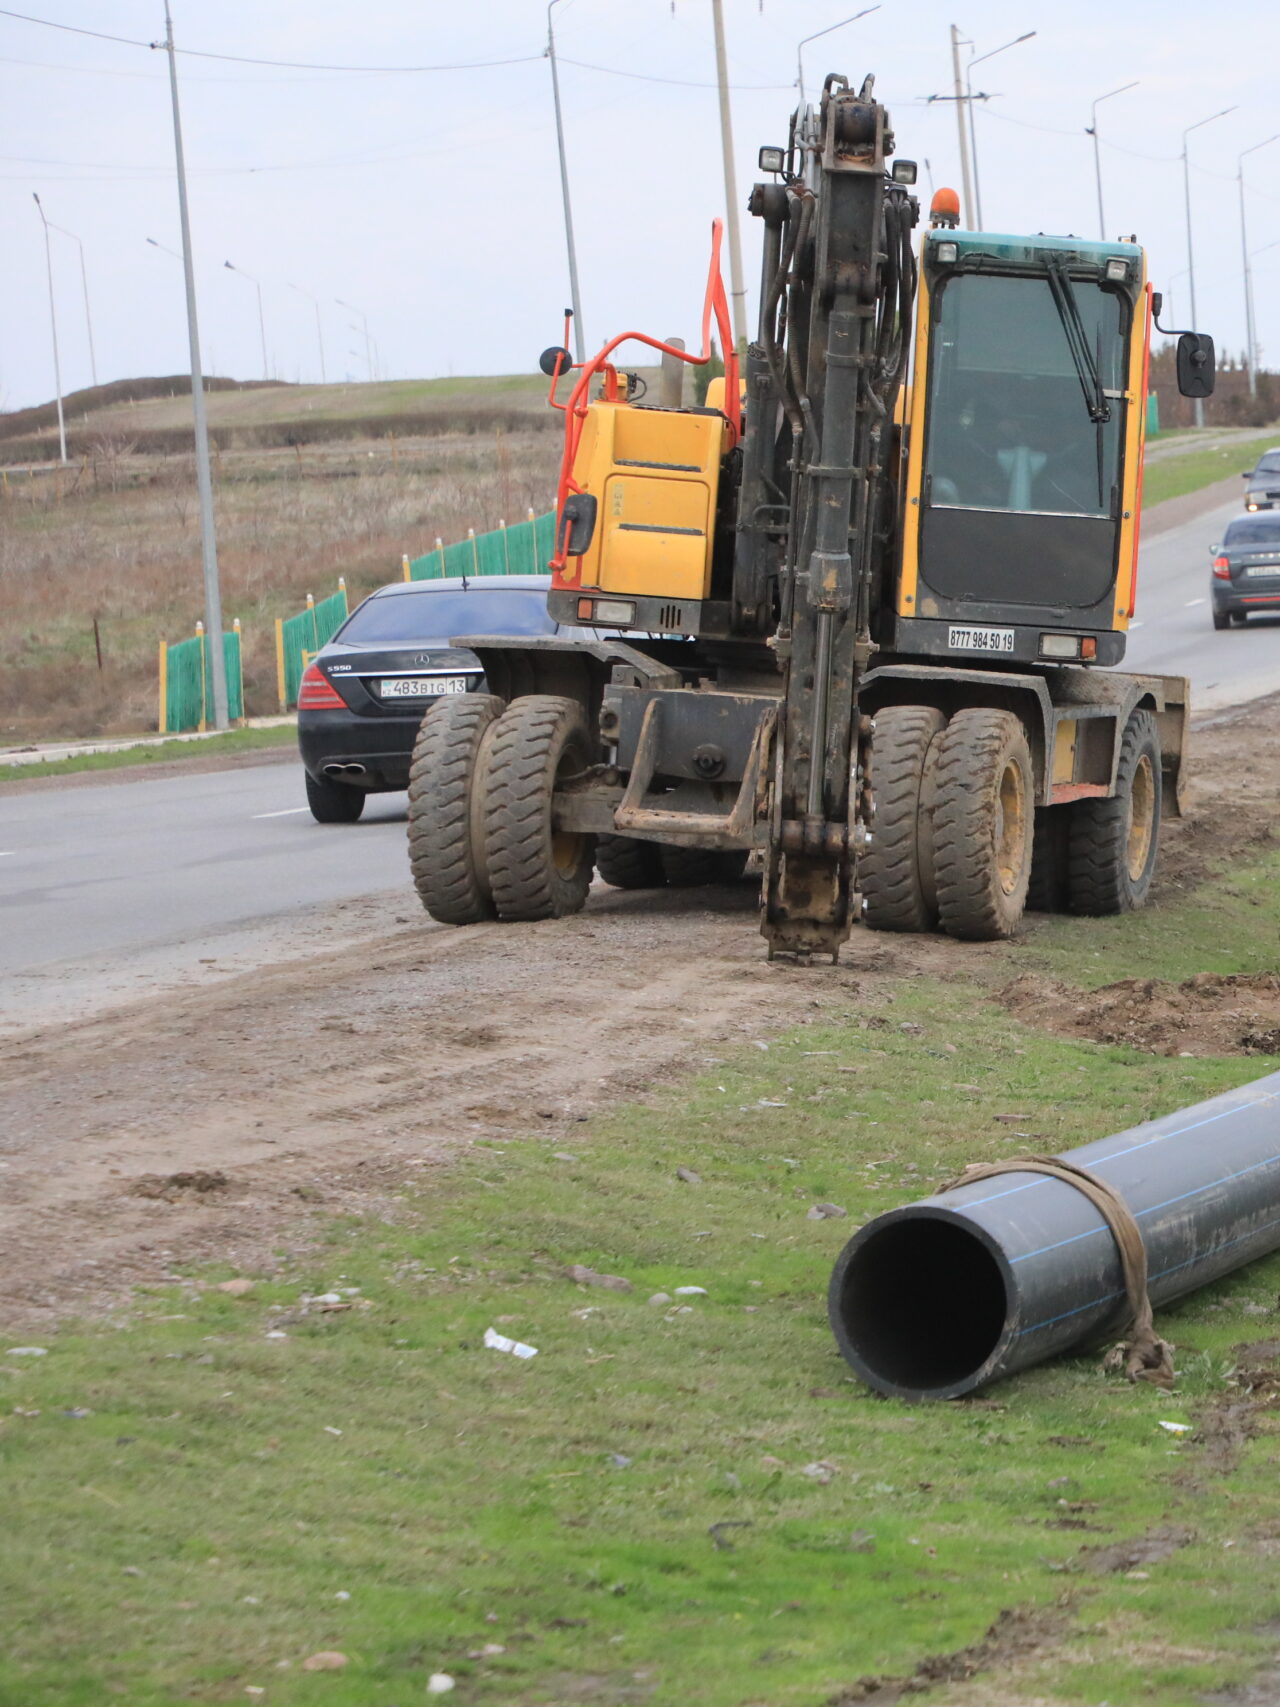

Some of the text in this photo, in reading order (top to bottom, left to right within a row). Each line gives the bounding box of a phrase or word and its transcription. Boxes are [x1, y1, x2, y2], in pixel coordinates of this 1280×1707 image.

[950, 631, 1013, 650] 8777 984 50 19
[448, 679, 465, 693] 13
